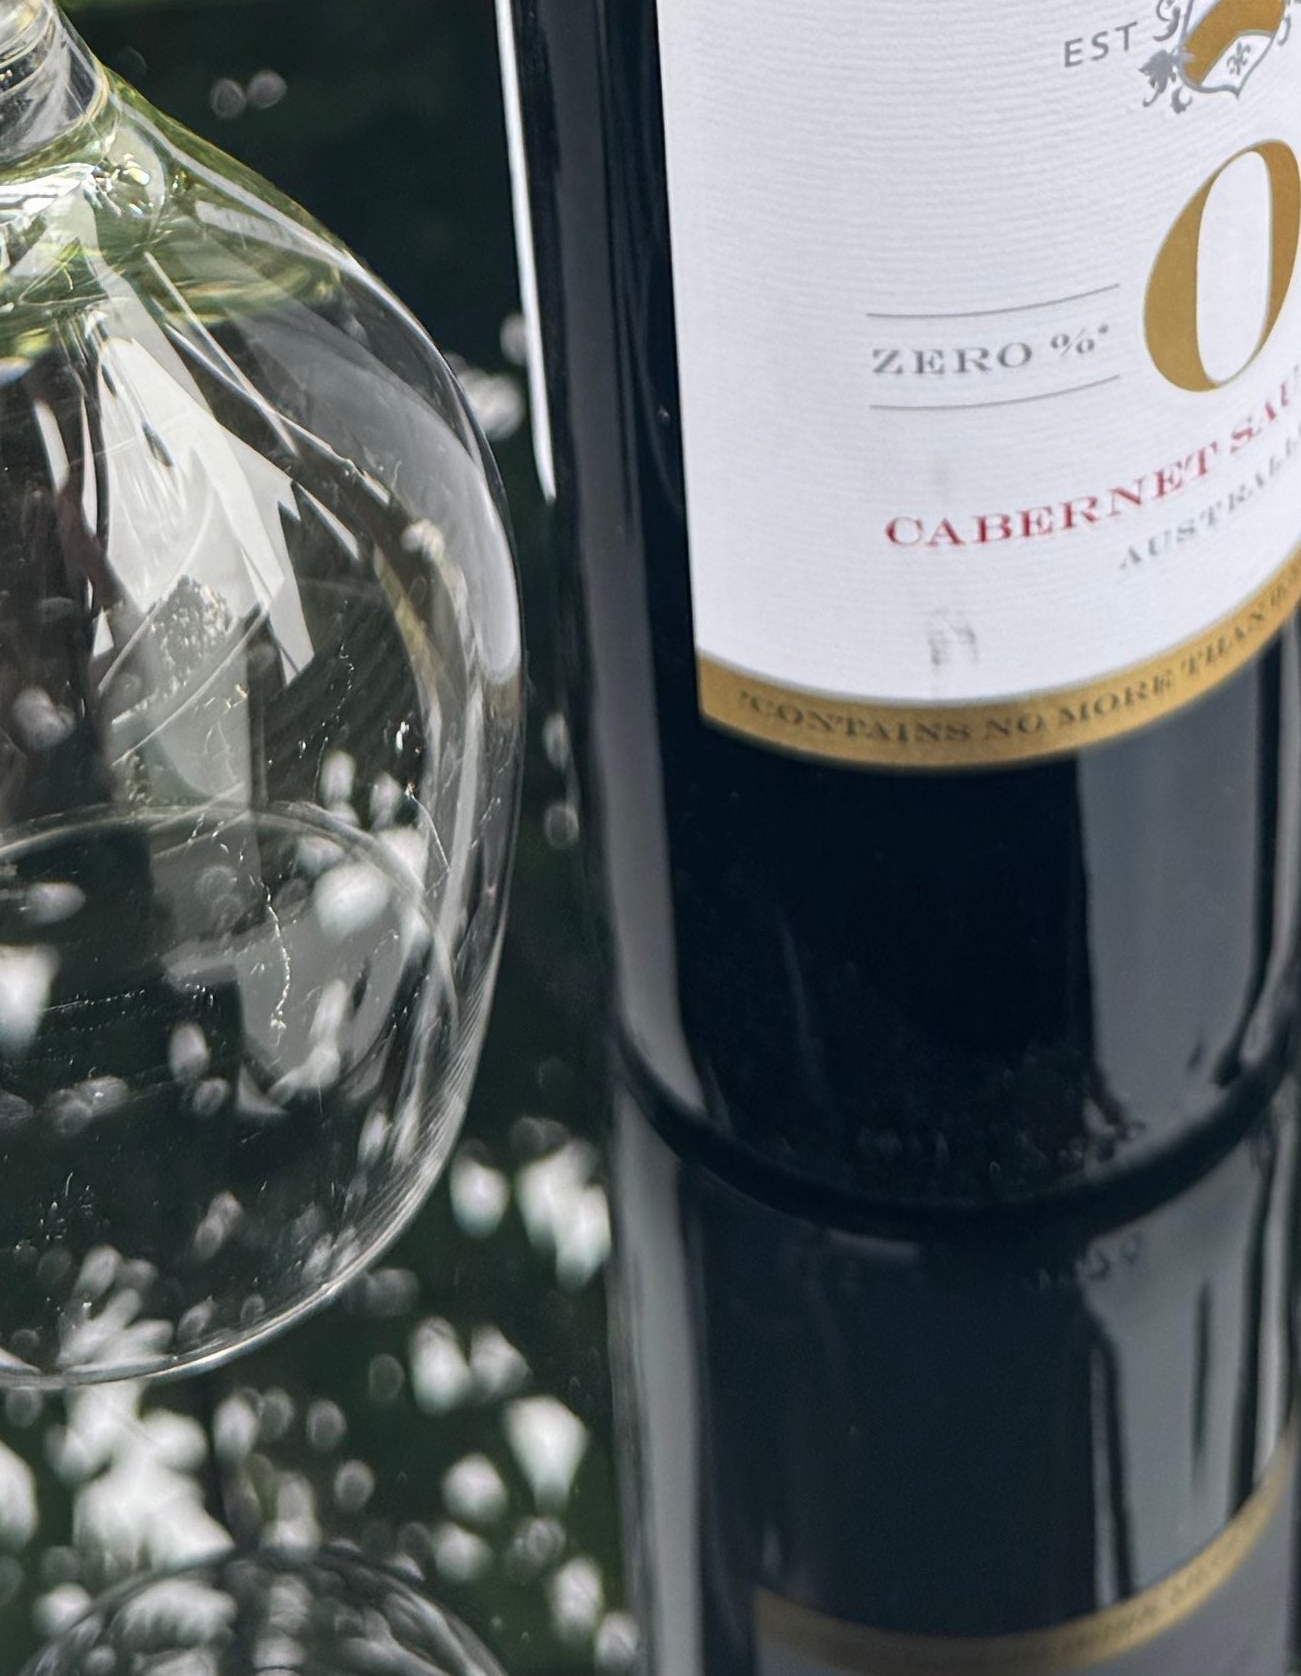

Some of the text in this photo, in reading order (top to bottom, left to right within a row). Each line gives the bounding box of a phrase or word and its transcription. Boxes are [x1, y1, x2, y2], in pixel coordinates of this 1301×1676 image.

[1062, 22, 1138, 70] EST
[871, 341, 1033, 376] ZERO
[884, 442, 1219, 549] CABERNET
[984, 714, 1045, 740] NO
[1058, 666, 1174, 726] MORE
